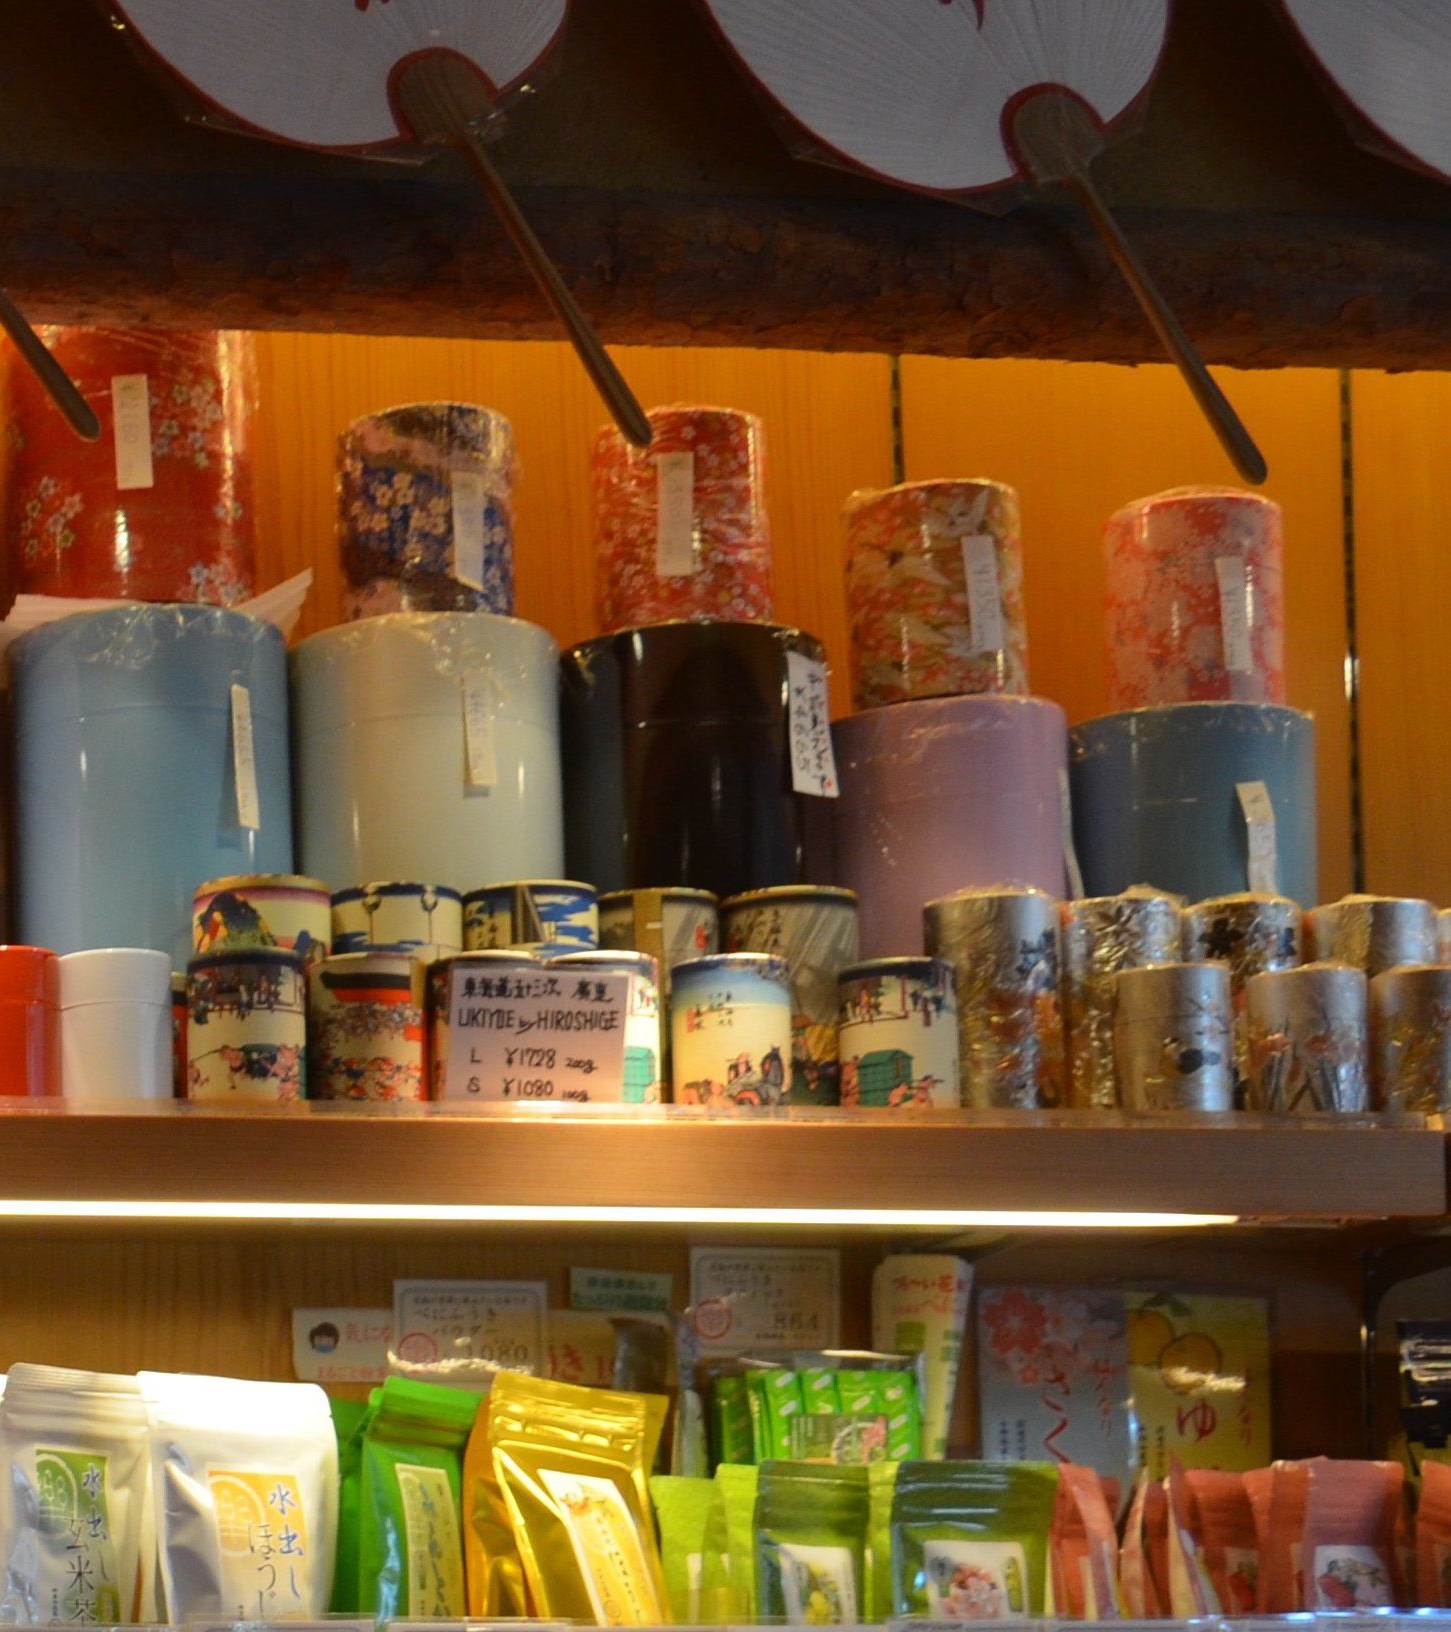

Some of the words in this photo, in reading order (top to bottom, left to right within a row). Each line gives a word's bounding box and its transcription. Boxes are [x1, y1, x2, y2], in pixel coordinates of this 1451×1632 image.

[537, 1009, 619, 1031] HIROSHIGE
[470, 1049, 482, 1063] L
[506, 1048, 557, 1069] ¥1728
[503, 1077, 554, 1097] ¥1080
[82, 1463, 109, 1582] 水出し
[268, 1483, 305, 1599] 水出し
[65, 1517, 98, 1625] 玄米茶
